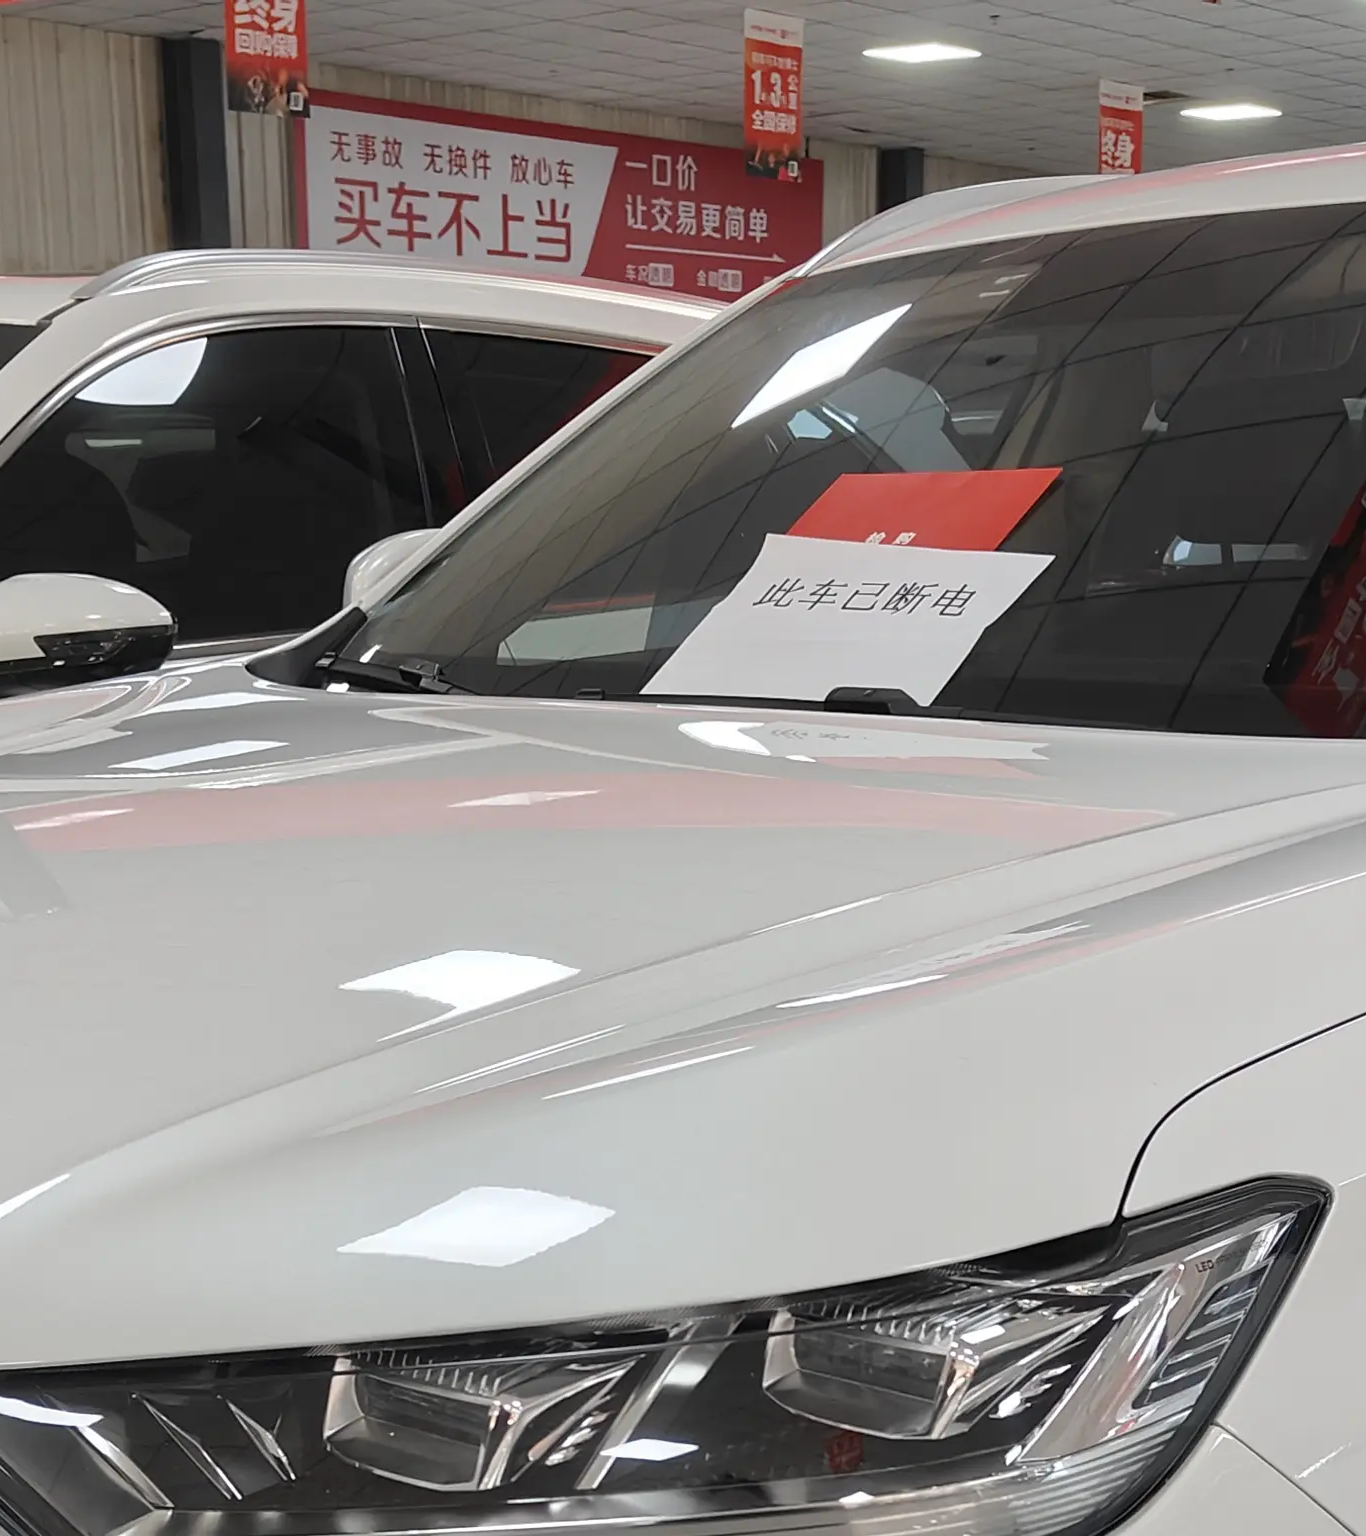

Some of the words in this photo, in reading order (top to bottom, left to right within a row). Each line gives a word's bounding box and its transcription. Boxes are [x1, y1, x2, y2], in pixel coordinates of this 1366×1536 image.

[330, 130, 403, 169] 无事故
[423, 143, 491, 181] 无换件
[510, 153, 575, 189] 放心车
[625, 154, 698, 192] 一口价
[334, 177, 571, 262] 买车不上当
[625, 194, 769, 243] 让交易更简单
[752, 577, 977, 617] 此车已断电
[1195, 1260, 1214, 1273] LED
